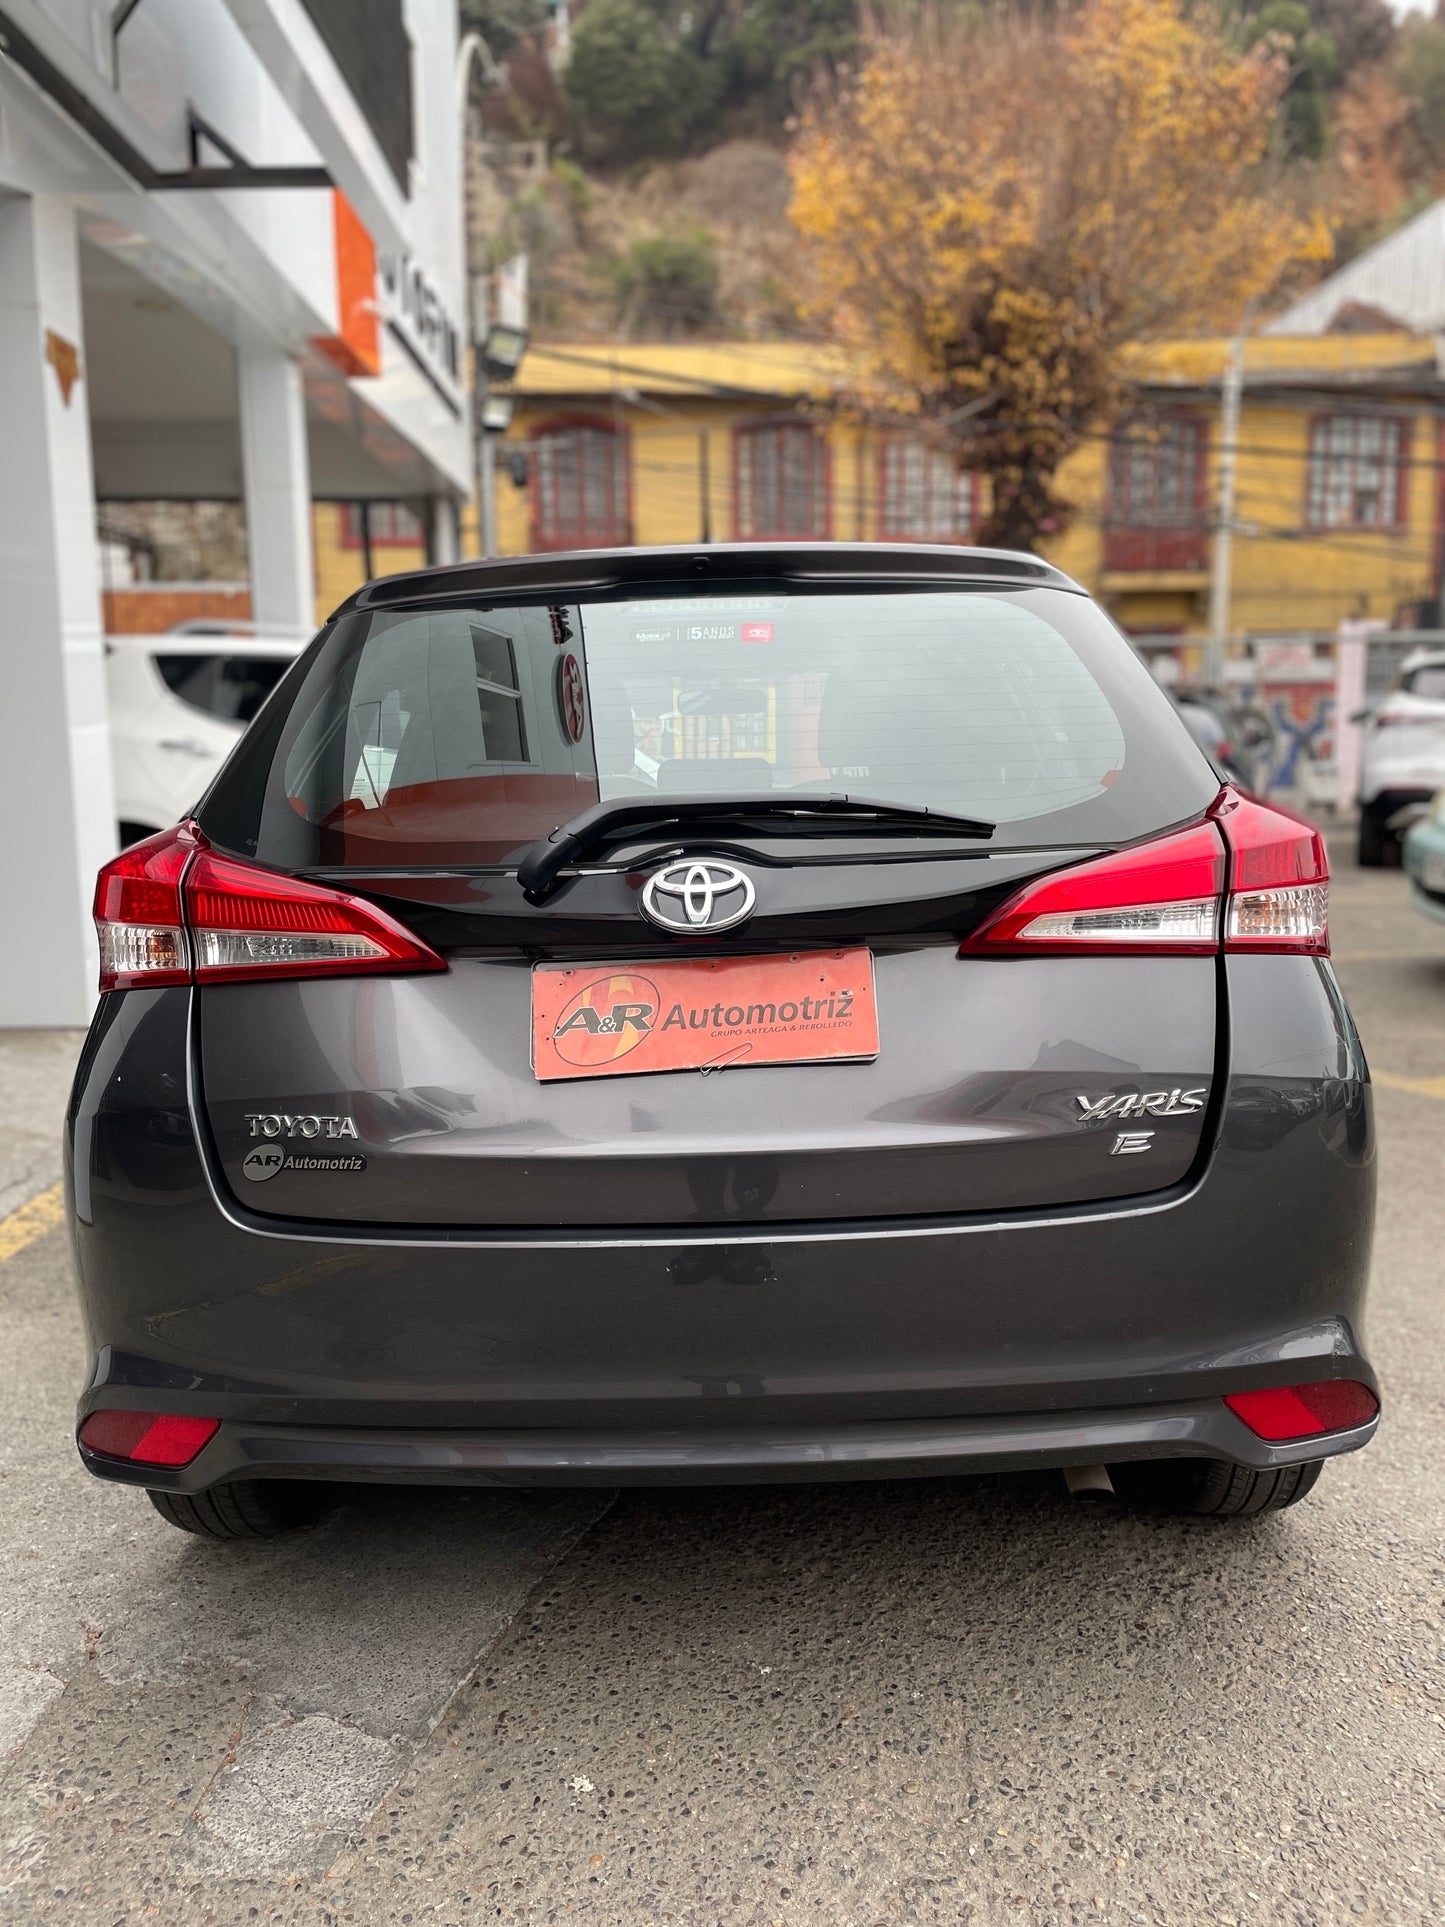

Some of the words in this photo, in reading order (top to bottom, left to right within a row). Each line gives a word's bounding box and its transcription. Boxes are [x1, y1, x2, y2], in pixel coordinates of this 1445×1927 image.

[690, 626, 702, 640] 5
[552, 1003, 654, 1038] A&R
[661, 991, 854, 1031] Automotriz
[711, 1028, 742, 1038] GRUPO
[744, 1025, 788, 1035] ARTEAGA
[789, 1024, 798, 1032] &
[799, 1020, 853, 1031] REBOLLEDO
[244, 1114, 359, 1140] TOYOTA
[1109, 1131, 1156, 1156] E
[244, 1154, 281, 1167] AR
[284, 1155, 363, 1170] Automotriz
